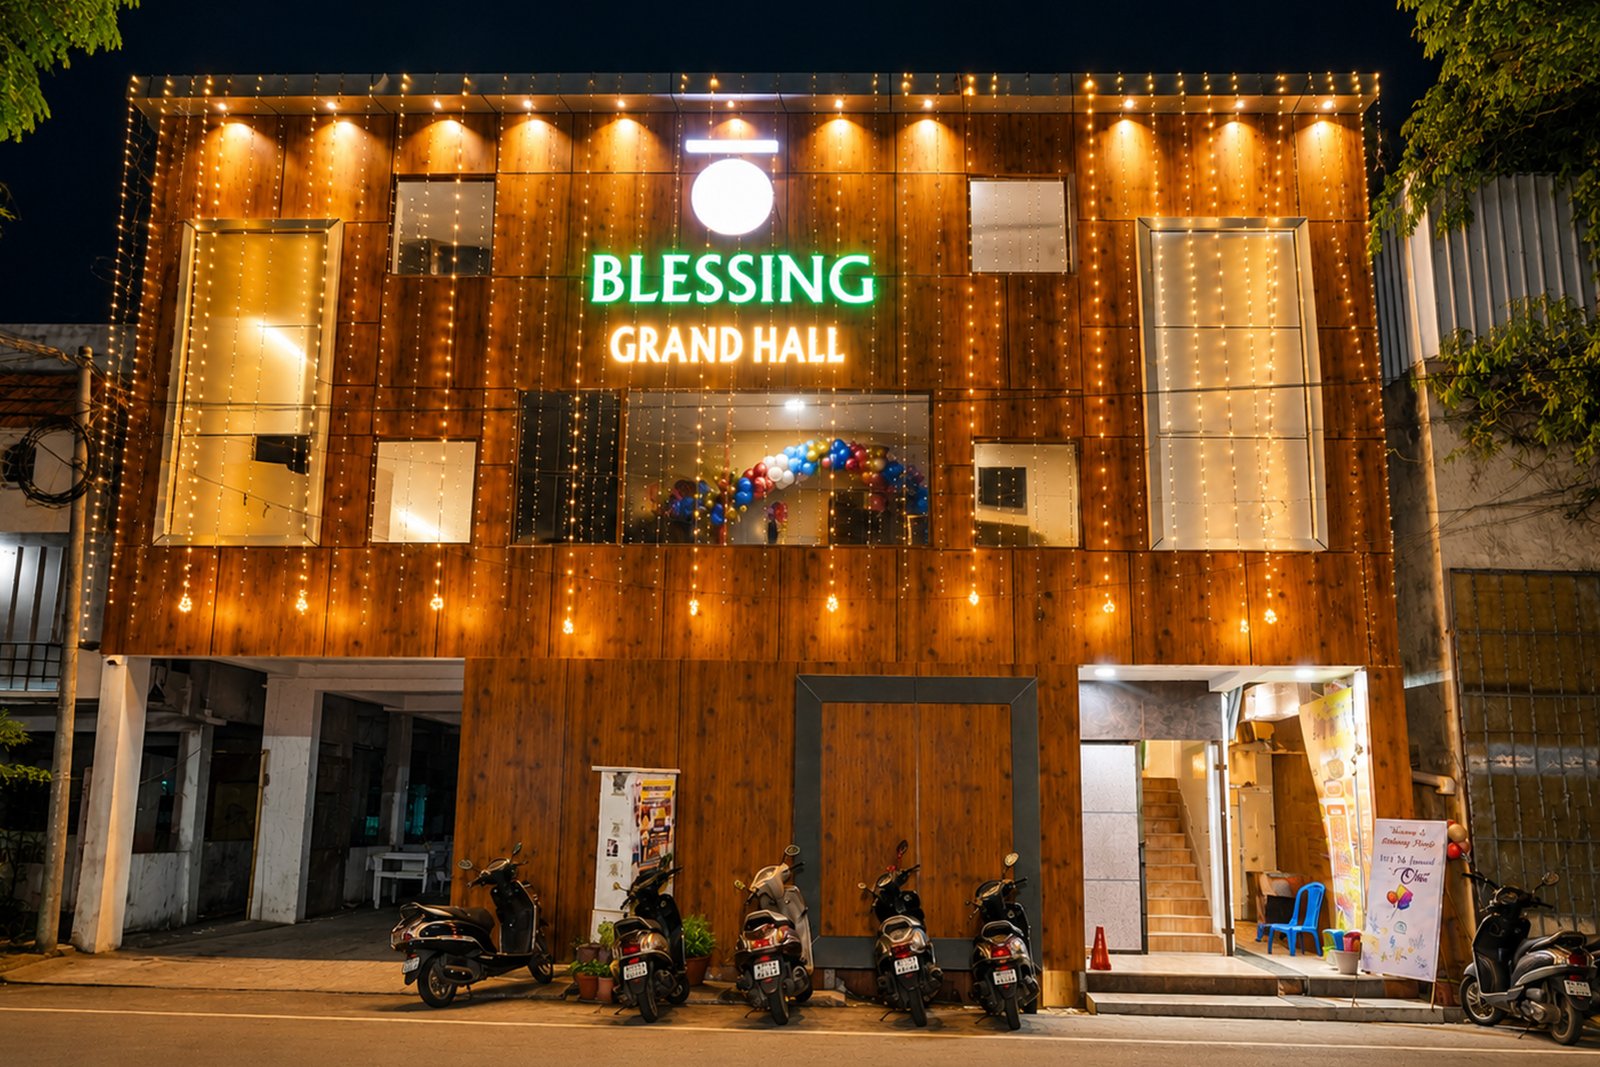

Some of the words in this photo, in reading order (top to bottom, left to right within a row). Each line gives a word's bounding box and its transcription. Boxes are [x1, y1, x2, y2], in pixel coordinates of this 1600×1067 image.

[591, 254, 875, 304] BLESSING
[610, 325, 743, 364] GRAND
[753, 326, 845, 364] HALL
